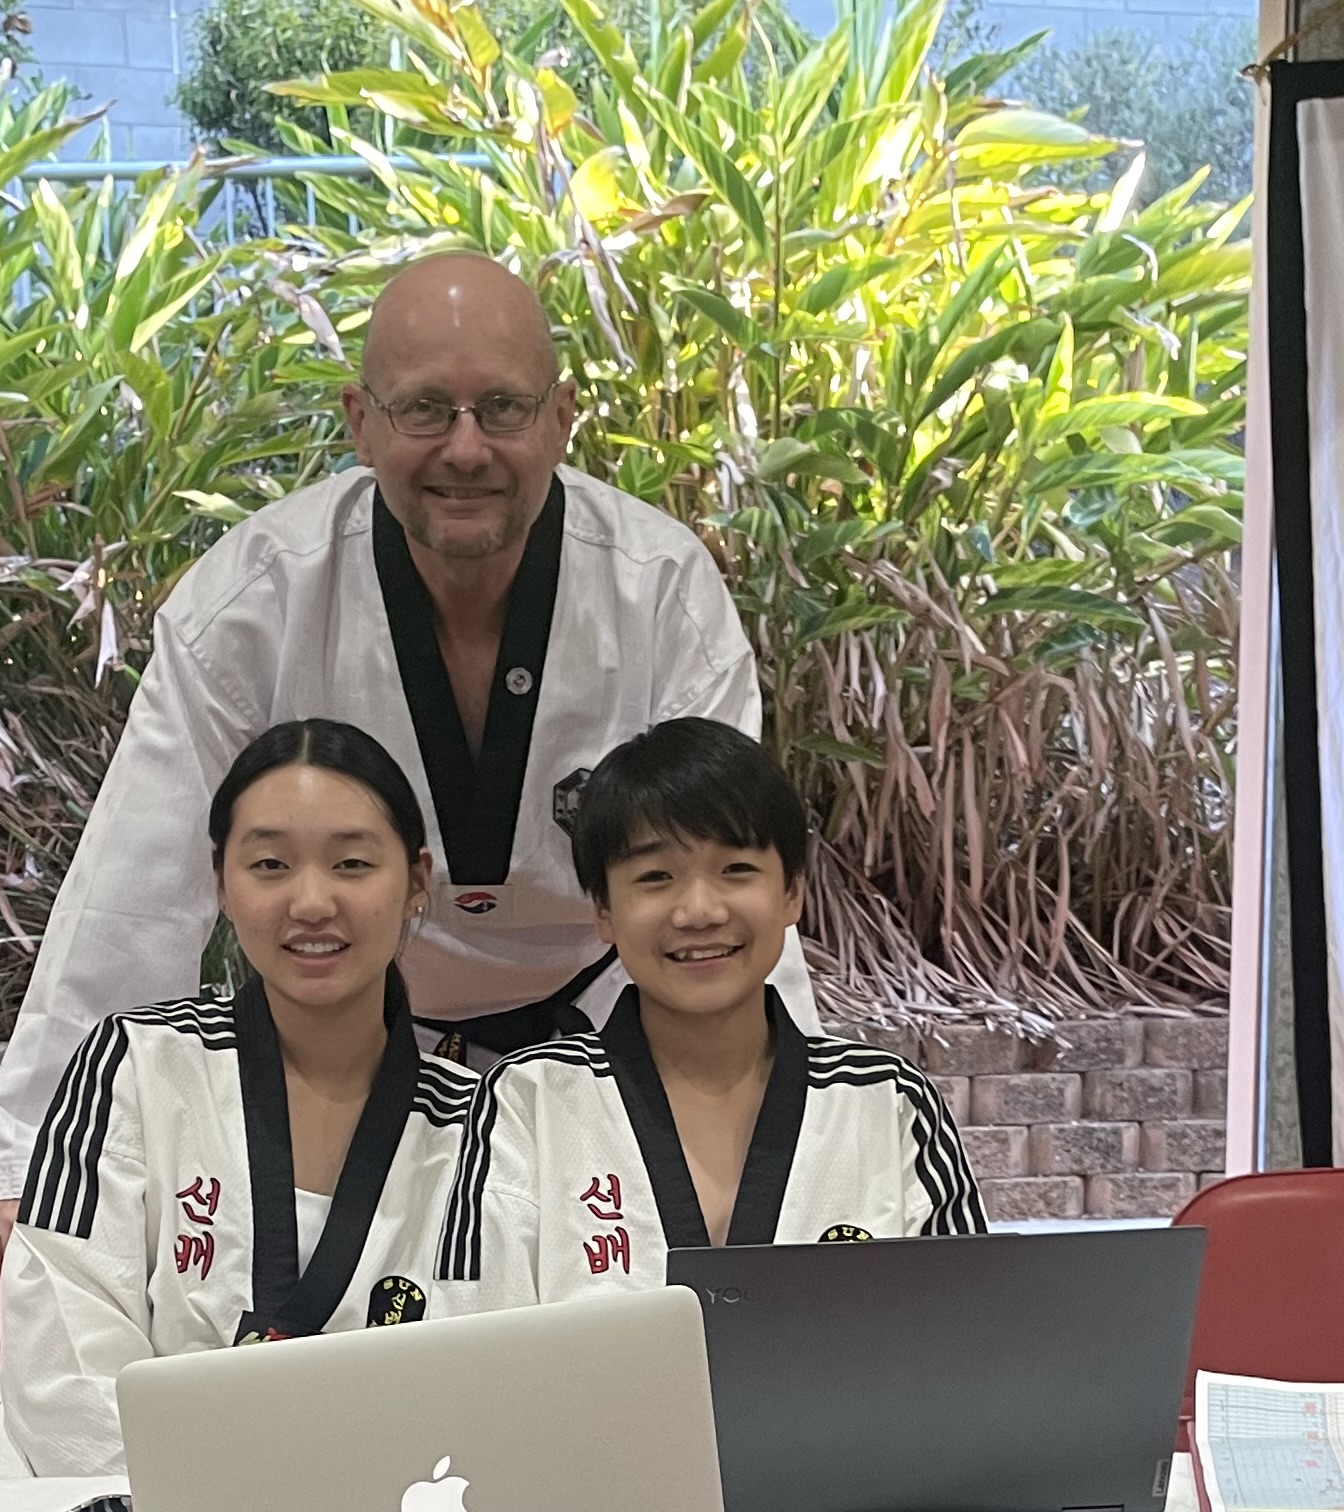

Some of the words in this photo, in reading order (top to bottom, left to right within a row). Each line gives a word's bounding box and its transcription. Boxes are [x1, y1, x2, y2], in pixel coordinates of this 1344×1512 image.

[174, 1176, 221, 1281] 선배
[580, 1174, 630, 1275] 선배
[827, 1227, 869, 1241] SUN
[383, 1279, 423, 1302] SUN
